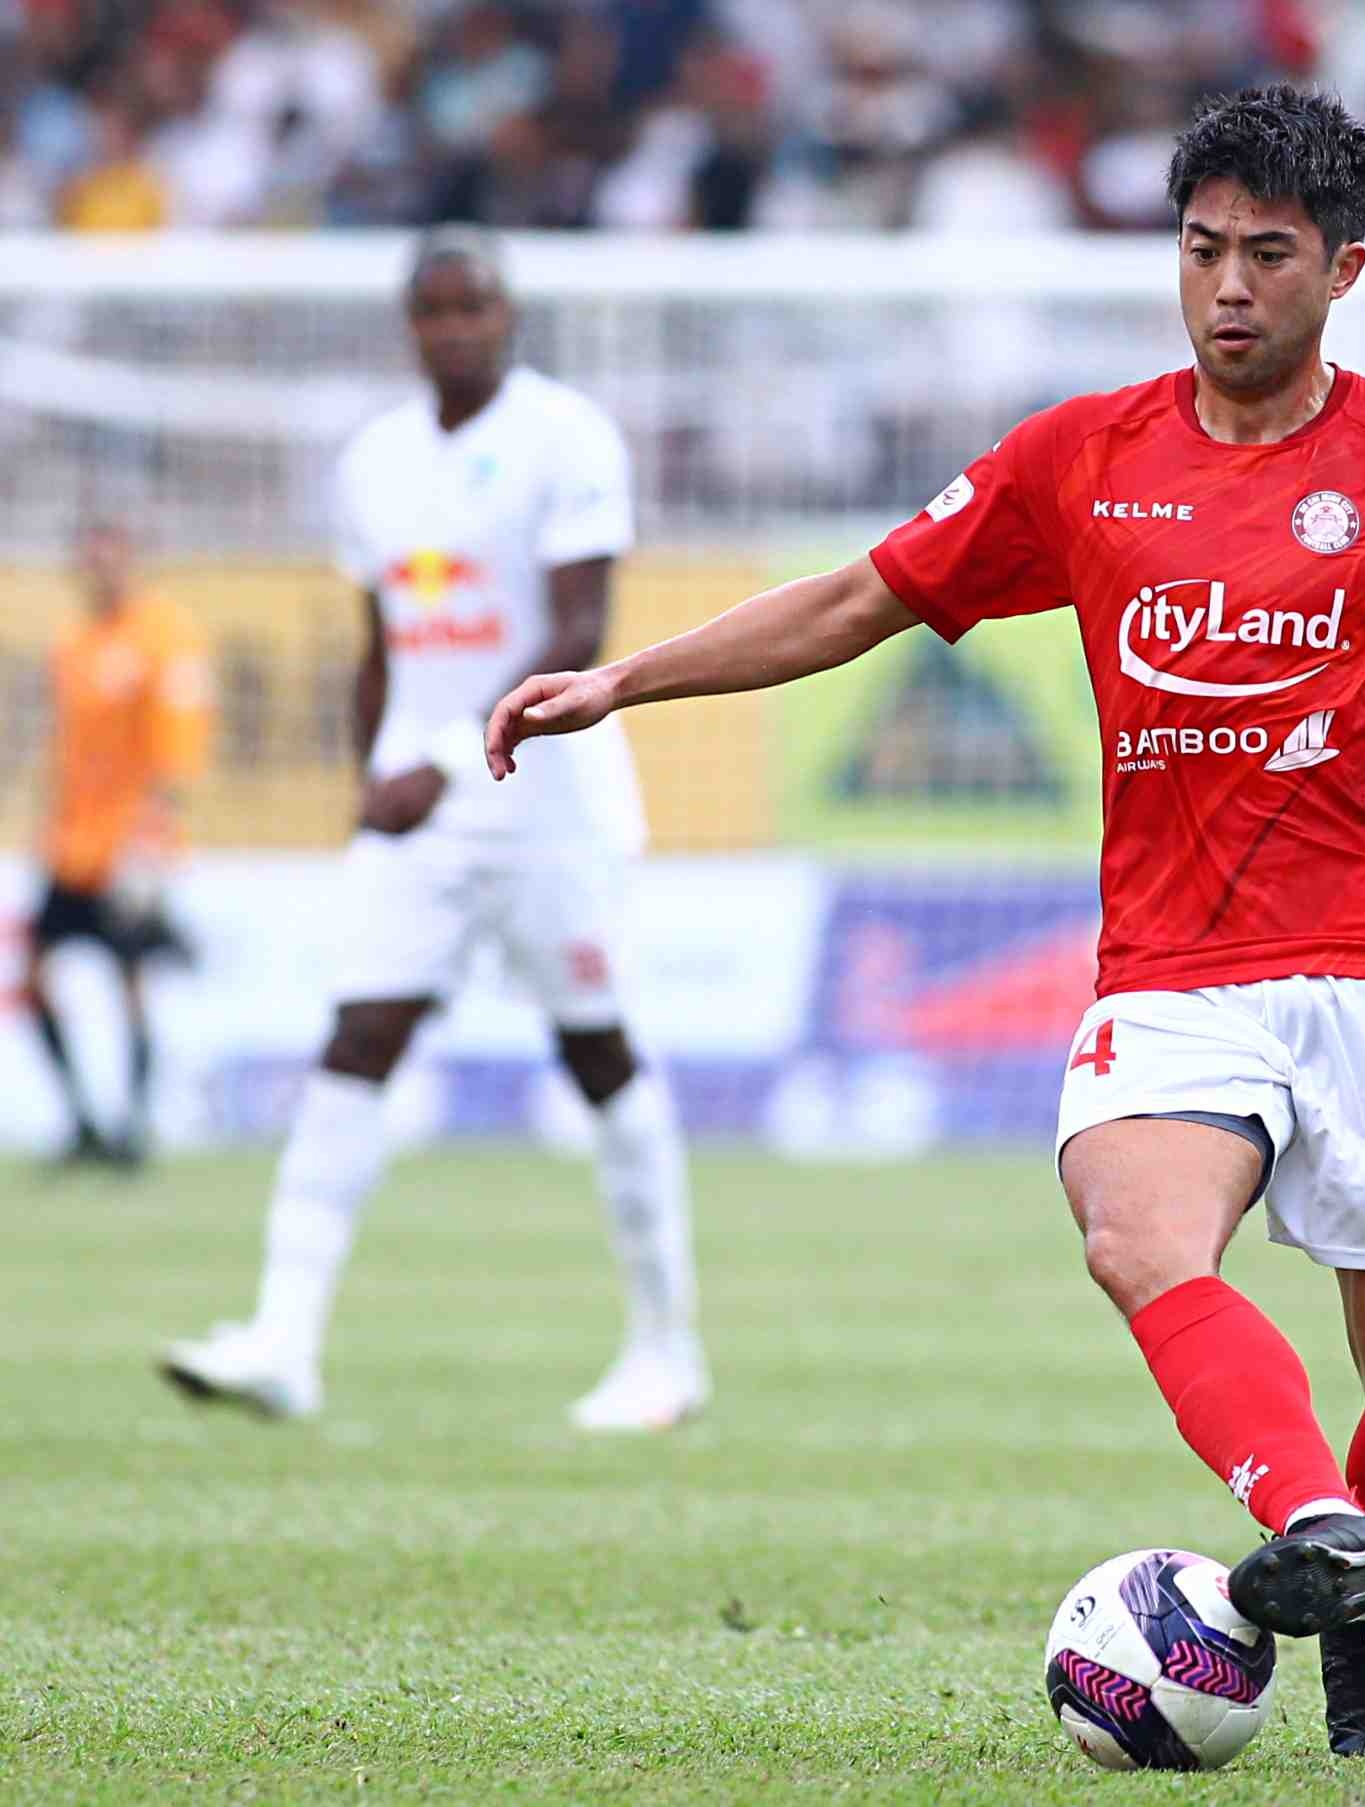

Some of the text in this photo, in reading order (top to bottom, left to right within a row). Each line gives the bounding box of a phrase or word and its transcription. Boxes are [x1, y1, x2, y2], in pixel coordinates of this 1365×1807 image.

[1093, 500, 1194, 521] KELME
[1118, 578, 1346, 697] CityLand
[1070, 1017, 1116, 1077] 4
